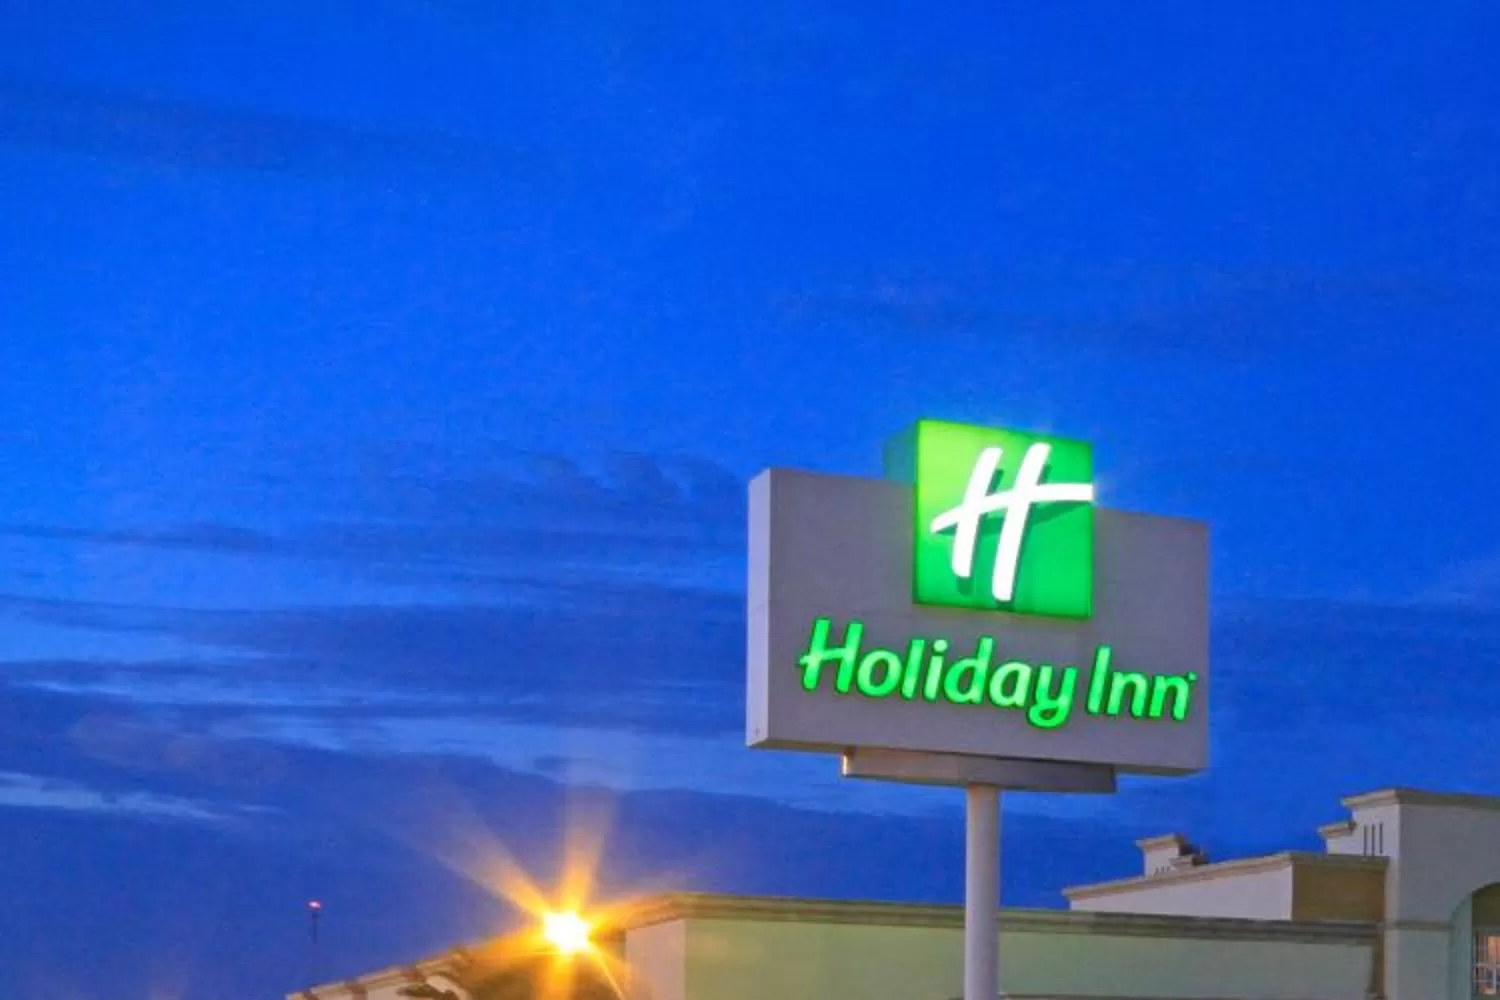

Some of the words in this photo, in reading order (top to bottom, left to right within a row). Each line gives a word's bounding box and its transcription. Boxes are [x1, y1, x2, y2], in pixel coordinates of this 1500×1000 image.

[930, 442, 1093, 601] H
[797, 618, 1077, 728] Holiday
[1088, 646, 1191, 721] Inn
